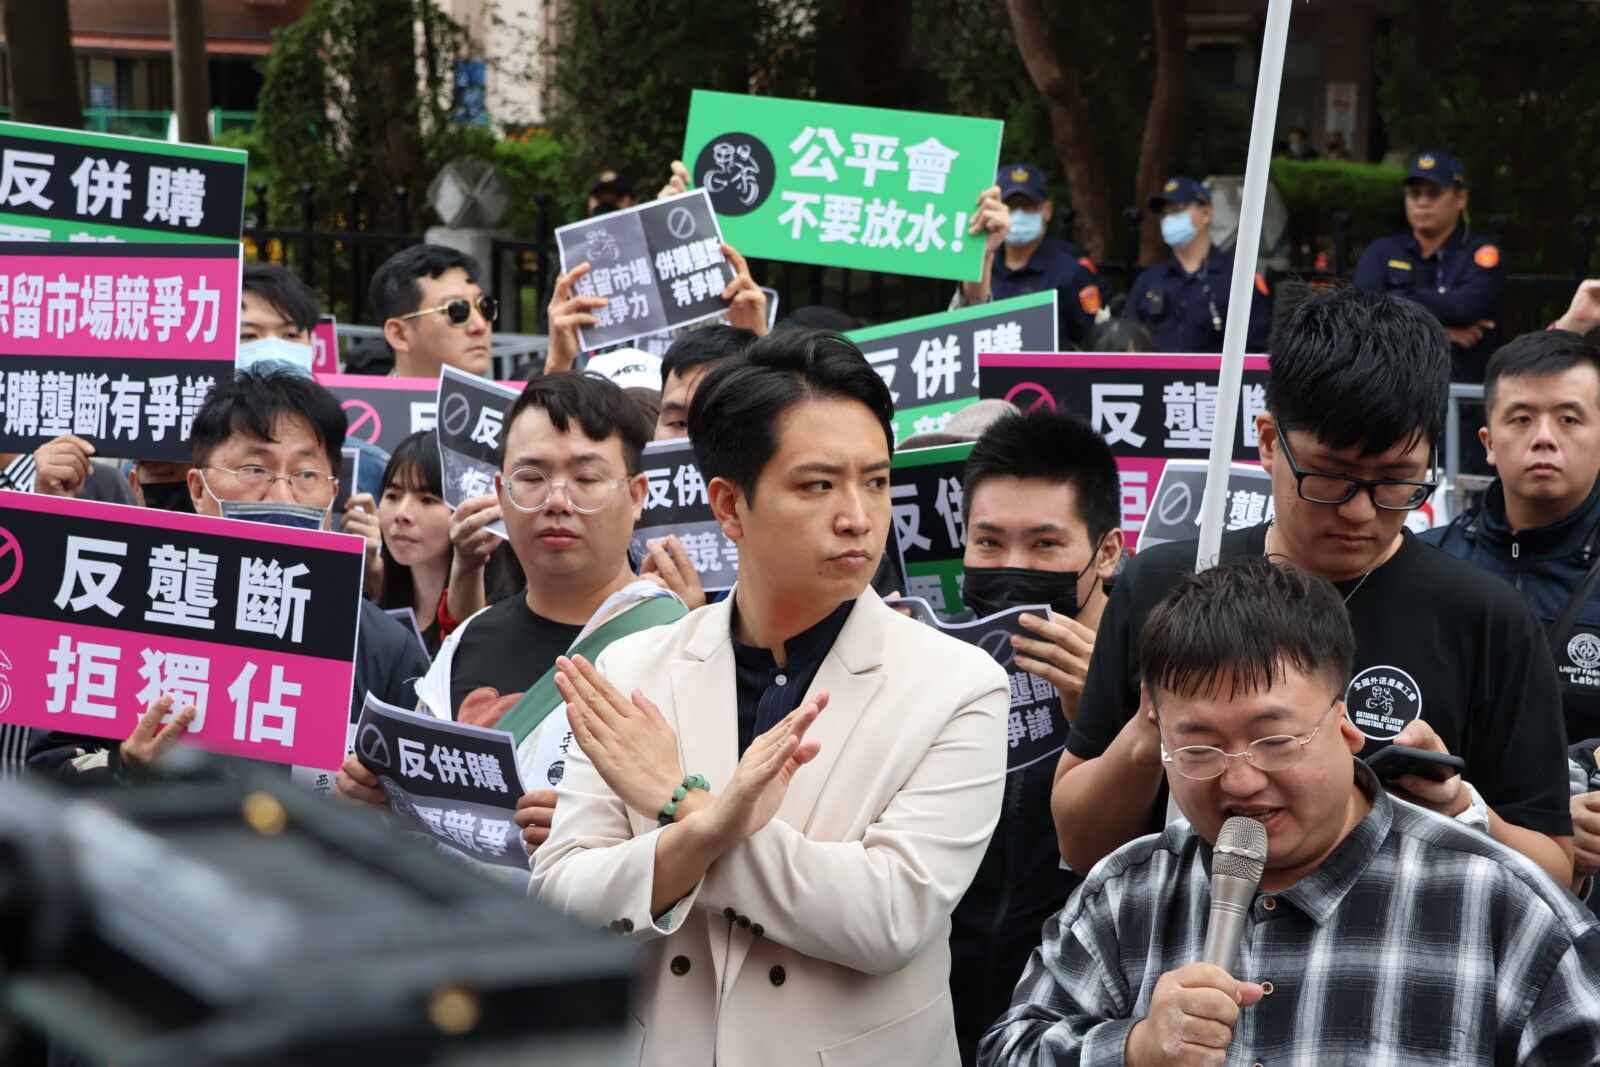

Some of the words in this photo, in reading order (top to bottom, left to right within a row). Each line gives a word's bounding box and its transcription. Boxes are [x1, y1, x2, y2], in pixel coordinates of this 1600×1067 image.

[0, 149, 207, 228] 反併購
[788, 125, 960, 195] 公平會
[777, 190, 968, 253] 不要放水!
[0, 370, 217, 442] 購壟斷有爭議
[54, 535, 312, 643] 反壟斷
[45, 635, 302, 747] 拒獨佔
[1356, 710, 1380, 721] NATIONAL
[1380, 715, 1405, 726] DELIVERY
[1356, 717, 1385, 729] INDUSTRIAL
[398, 736, 509, 793] 反併購
